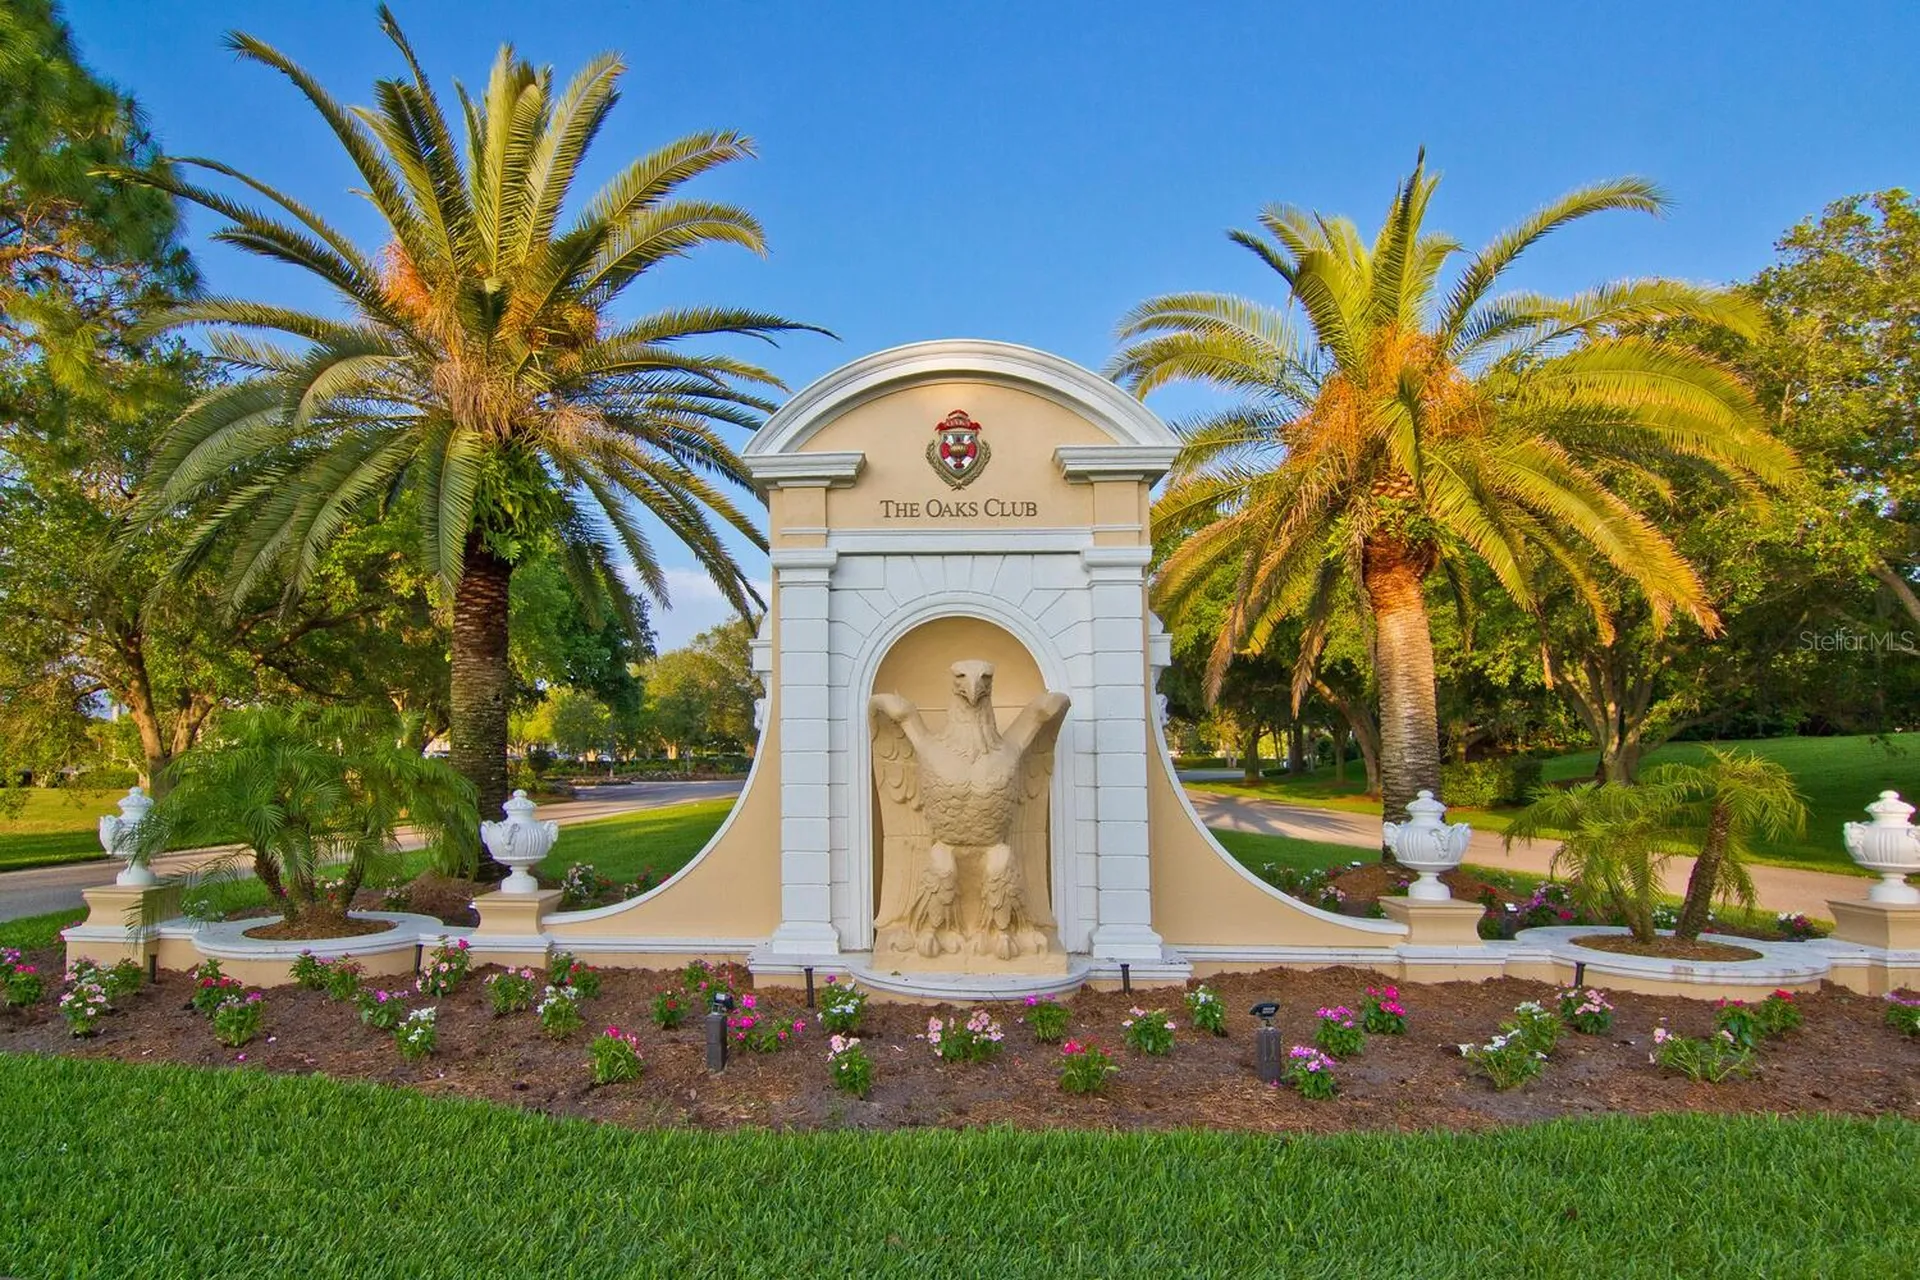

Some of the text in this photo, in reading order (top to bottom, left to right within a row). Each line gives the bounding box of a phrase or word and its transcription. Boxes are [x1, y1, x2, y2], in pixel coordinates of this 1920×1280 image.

[880, 498, 1038, 518] THE OAKS CLUB
